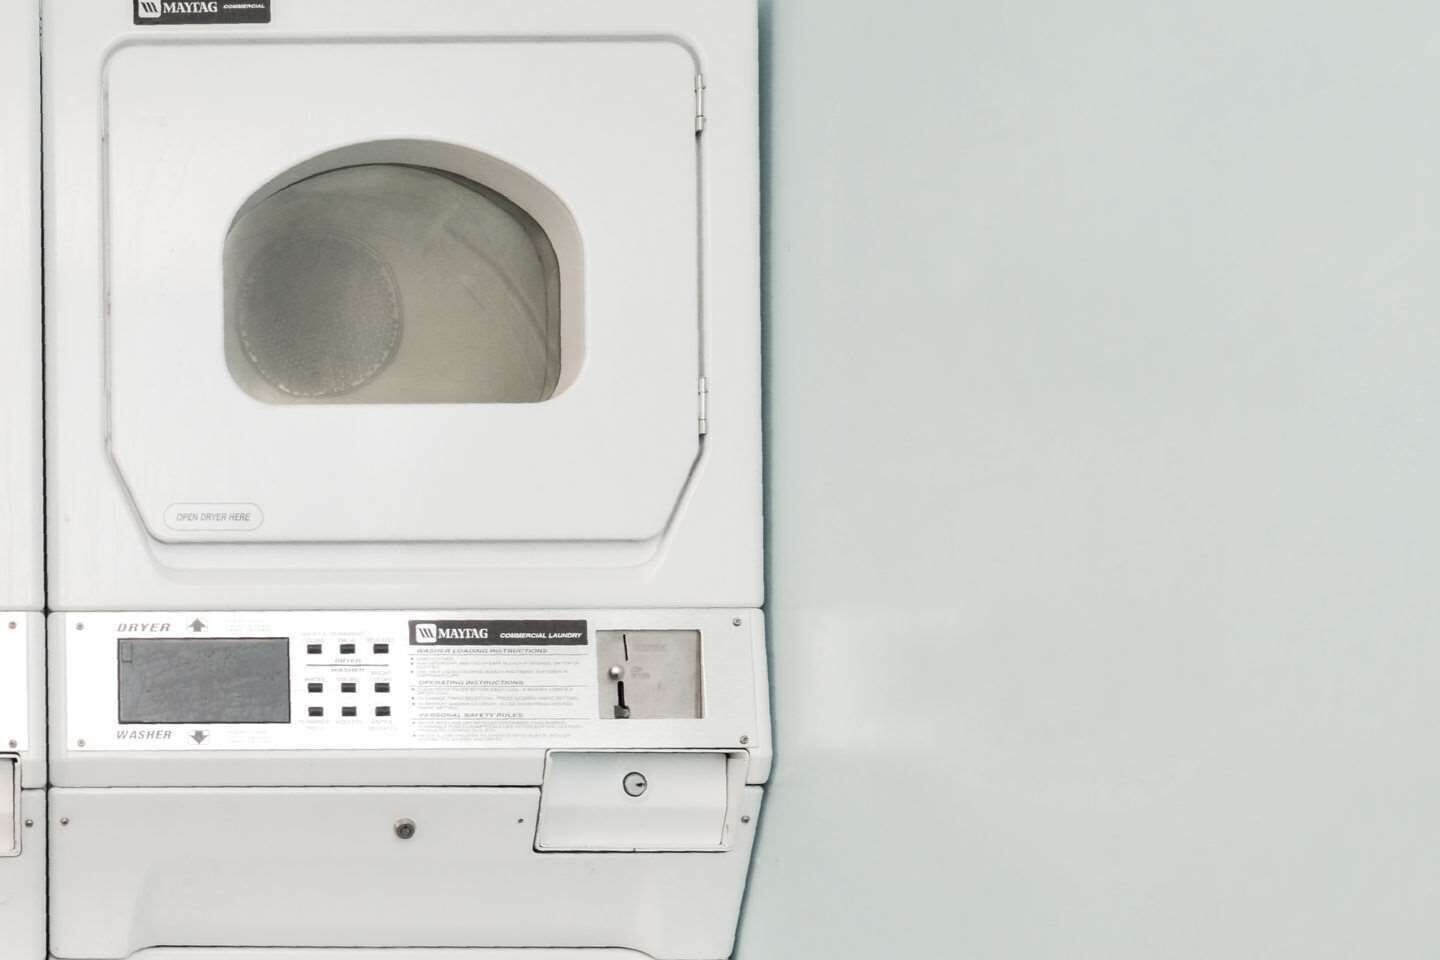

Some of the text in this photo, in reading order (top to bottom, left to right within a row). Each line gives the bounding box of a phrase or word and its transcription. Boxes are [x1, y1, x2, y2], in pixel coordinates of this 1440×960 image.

[162, 2, 218, 13] MAYTAG
[176, 512, 251, 521] OPEN DRYER HERE
[117, 622, 171, 633] DRYER
[438, 627, 582, 639] MAYTAG COMMERCIAL LAUNDRY
[116, 729, 172, 741] WASHER
